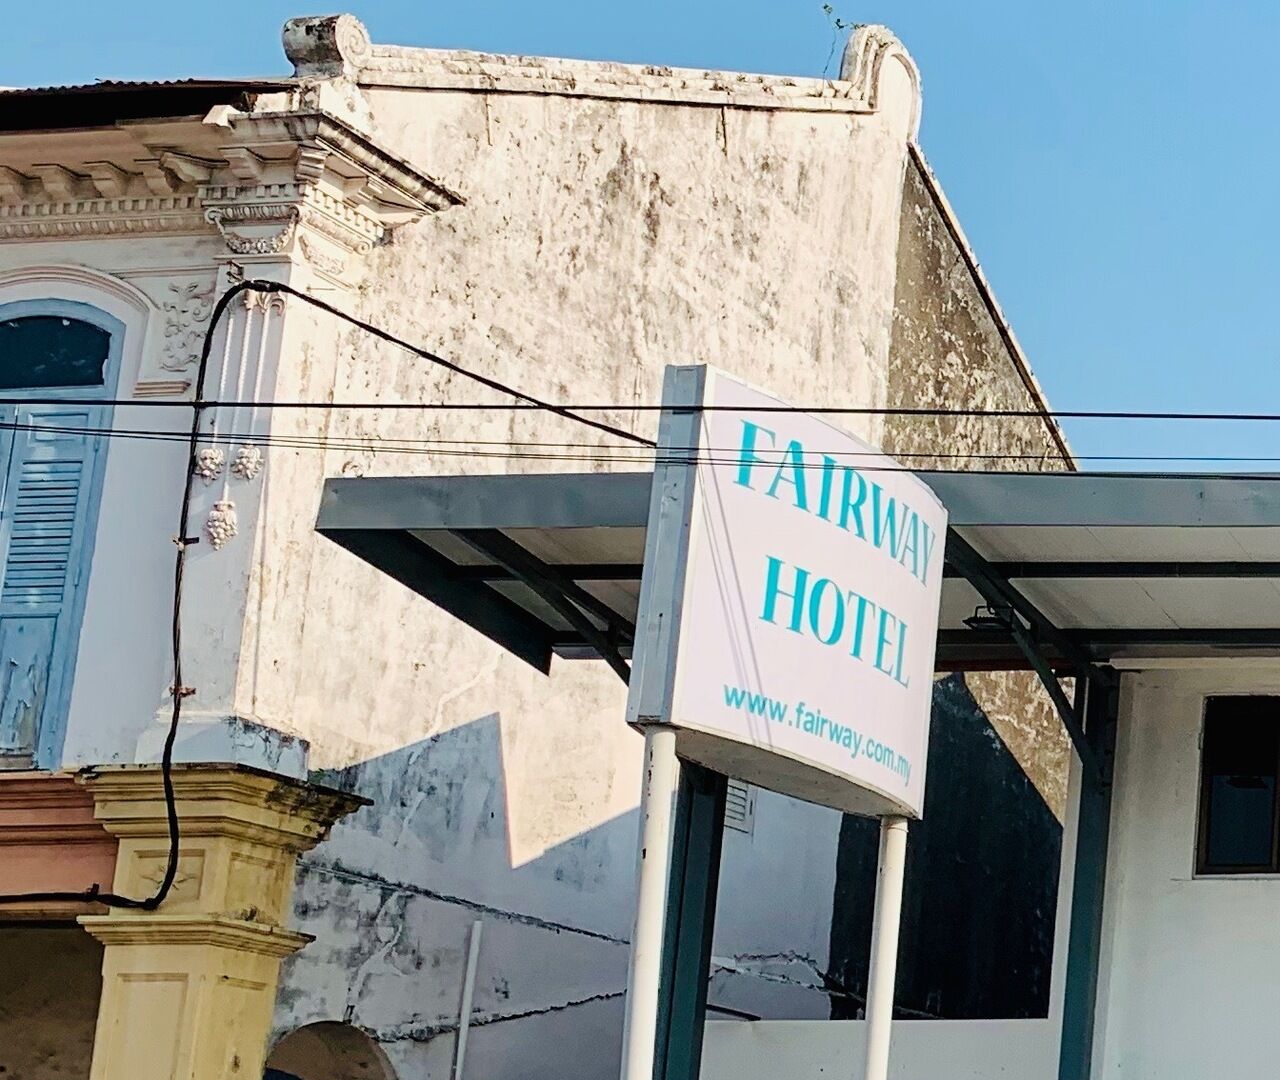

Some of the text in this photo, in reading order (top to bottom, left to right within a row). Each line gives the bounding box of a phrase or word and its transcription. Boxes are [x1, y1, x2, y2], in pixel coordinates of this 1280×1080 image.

[732, 418, 936, 588] FAIRWAY
[758, 554, 911, 689] HOTEL
[722, 681, 913, 787] www.fairway.com.my
